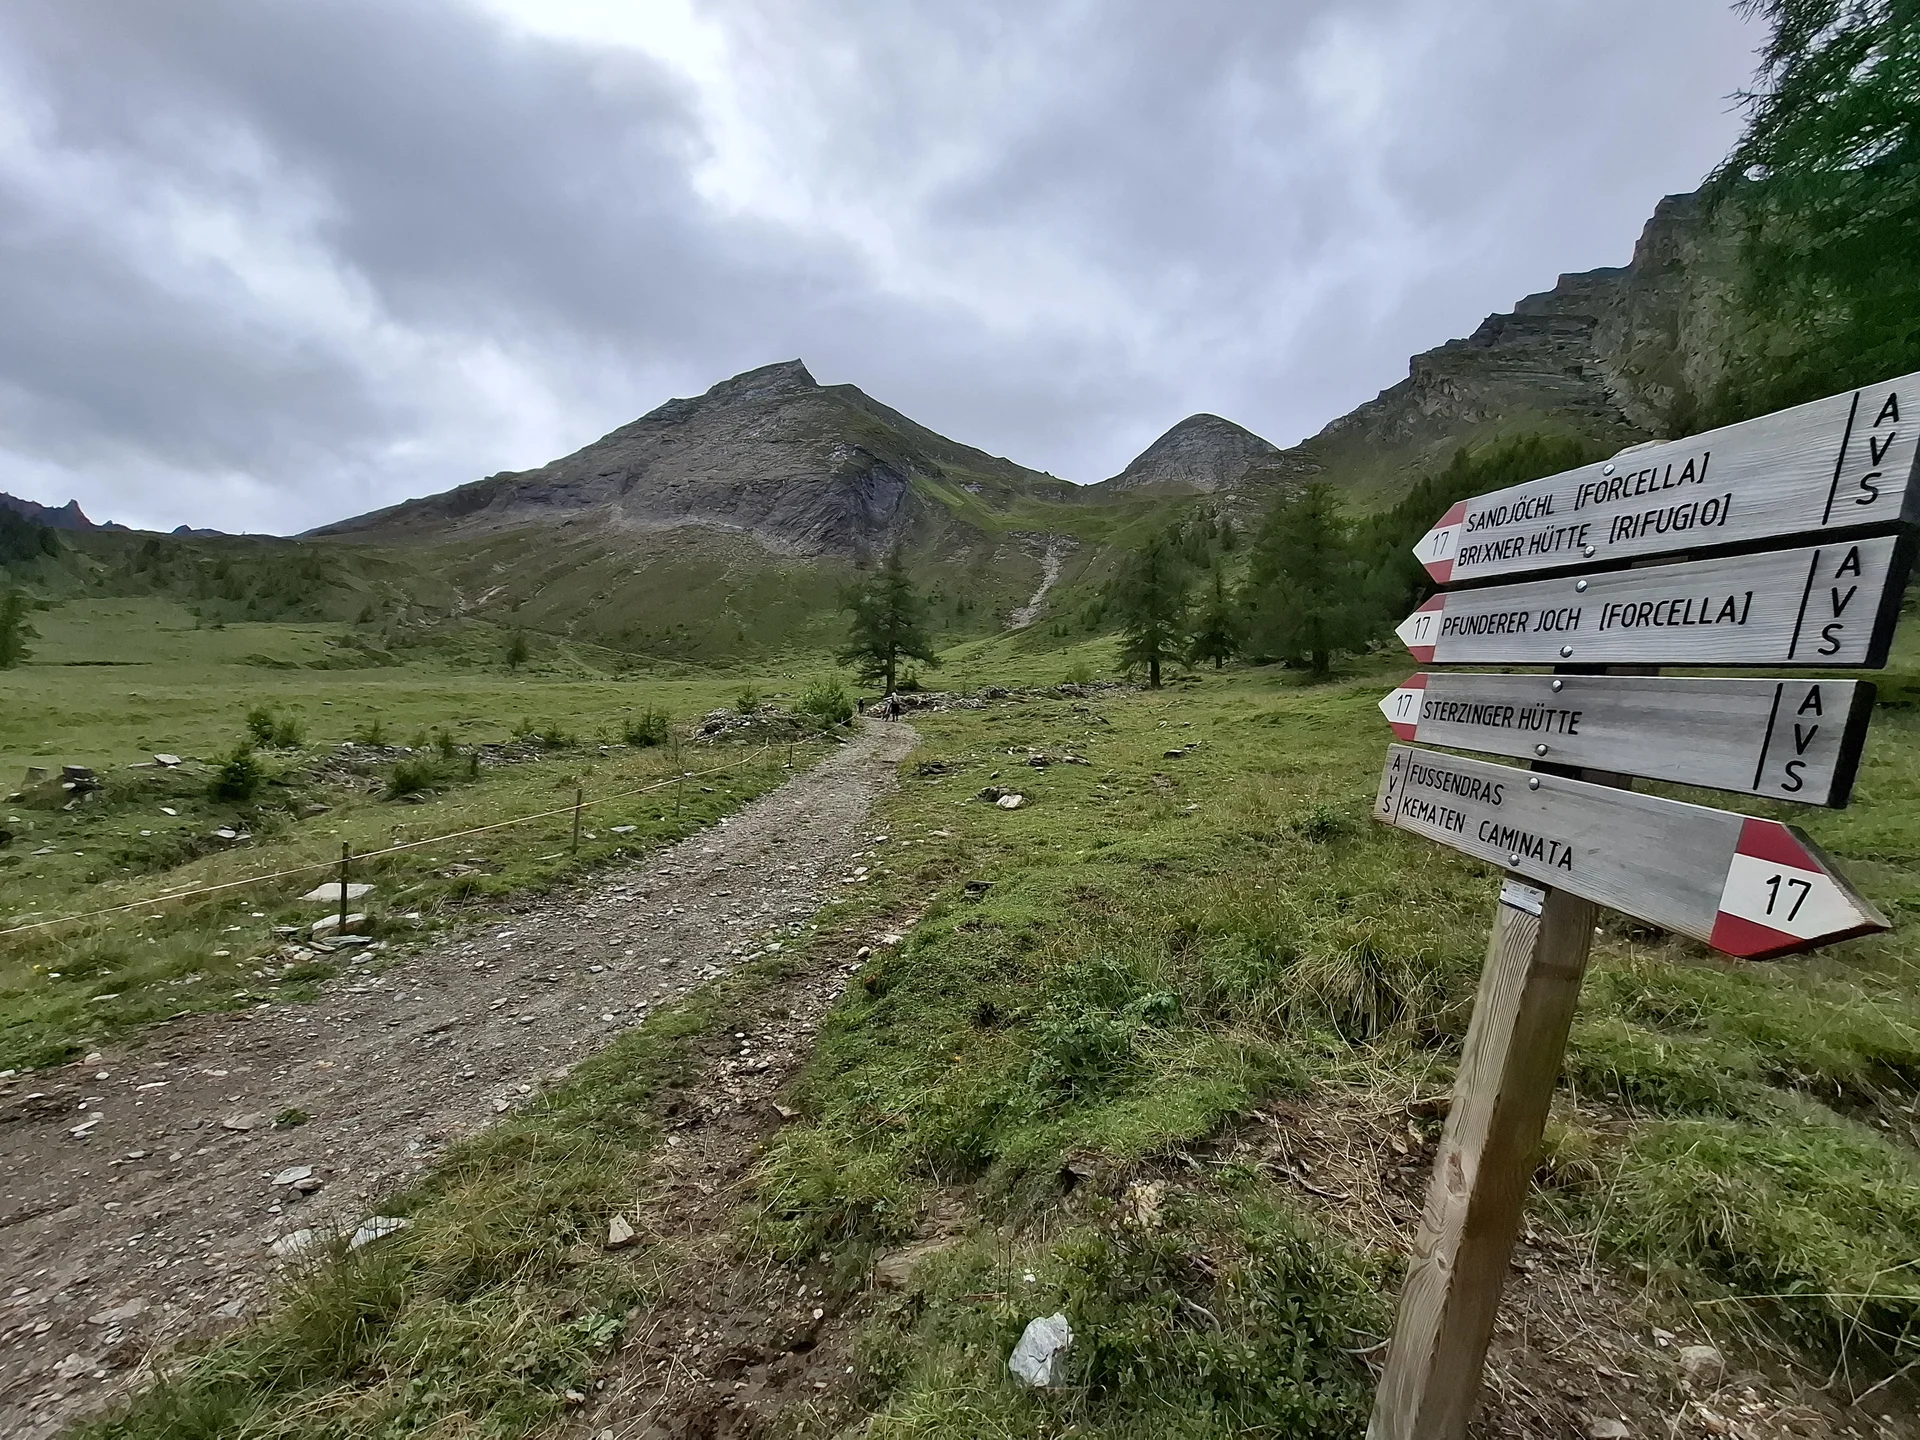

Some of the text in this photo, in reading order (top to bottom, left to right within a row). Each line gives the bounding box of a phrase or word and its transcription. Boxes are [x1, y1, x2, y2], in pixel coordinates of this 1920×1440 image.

[1466, 451, 1710, 532] SANDJÖCHL [FORCELLA]
[1433, 531, 1449, 556] 17
[1457, 493, 1732, 567] BRIXNER HÜTTE [RIFUGIO]
[1414, 616, 1431, 639] 17
[1441, 591, 1753, 636] PFUNDERER JOCH [FORCELLA]
[1397, 694, 1412, 717] 17
[1422, 701, 1583, 735] STERZINGER HÜTTE
[1410, 764, 1504, 806] FUSSENDRAS
[1401, 796, 1573, 871] KEMATEN CAMINATA
[1766, 874, 1812, 922] 17
